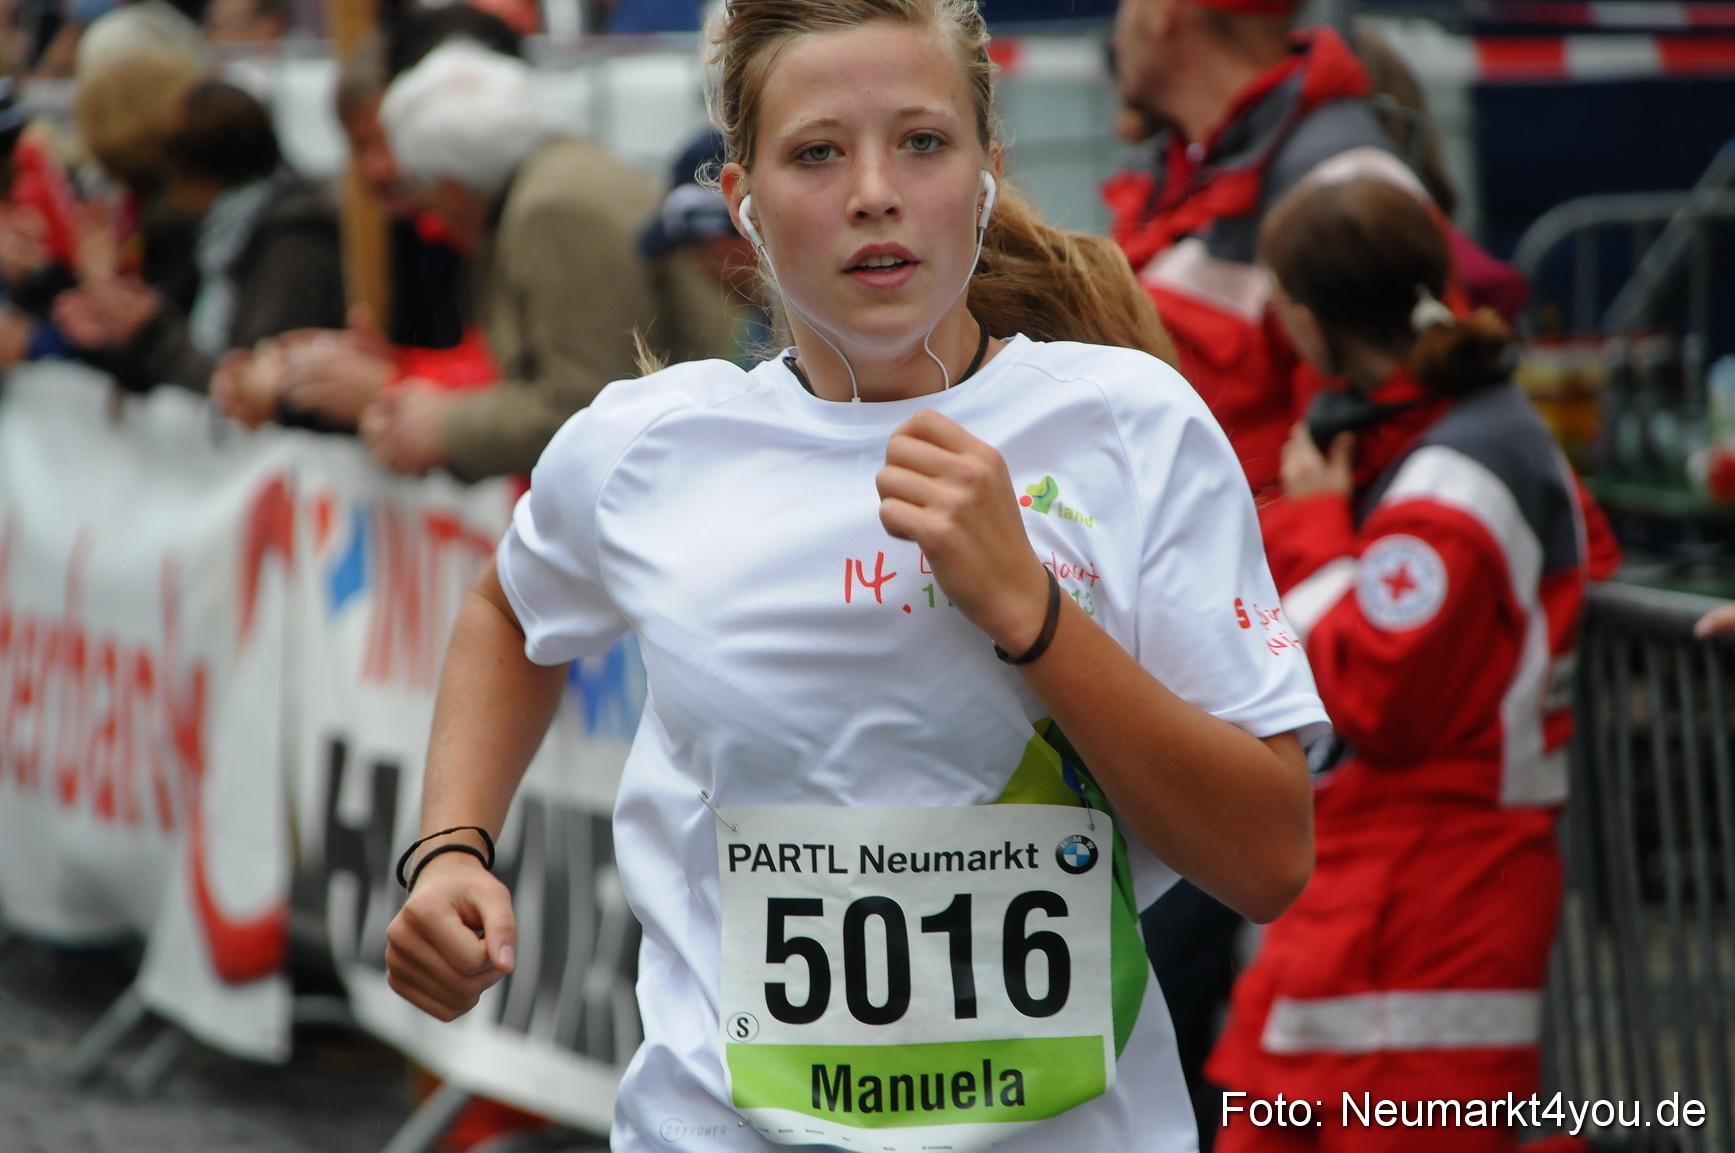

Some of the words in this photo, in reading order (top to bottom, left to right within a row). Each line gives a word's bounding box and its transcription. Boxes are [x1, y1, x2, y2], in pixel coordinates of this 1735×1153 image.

[844, 551, 912, 613] 14.
[728, 842, 848, 875] PARTL
[859, 841, 1040, 875] Neumarkt
[764, 890, 1072, 1026] 5016
[811, 1059, 1027, 1114] Manuela
